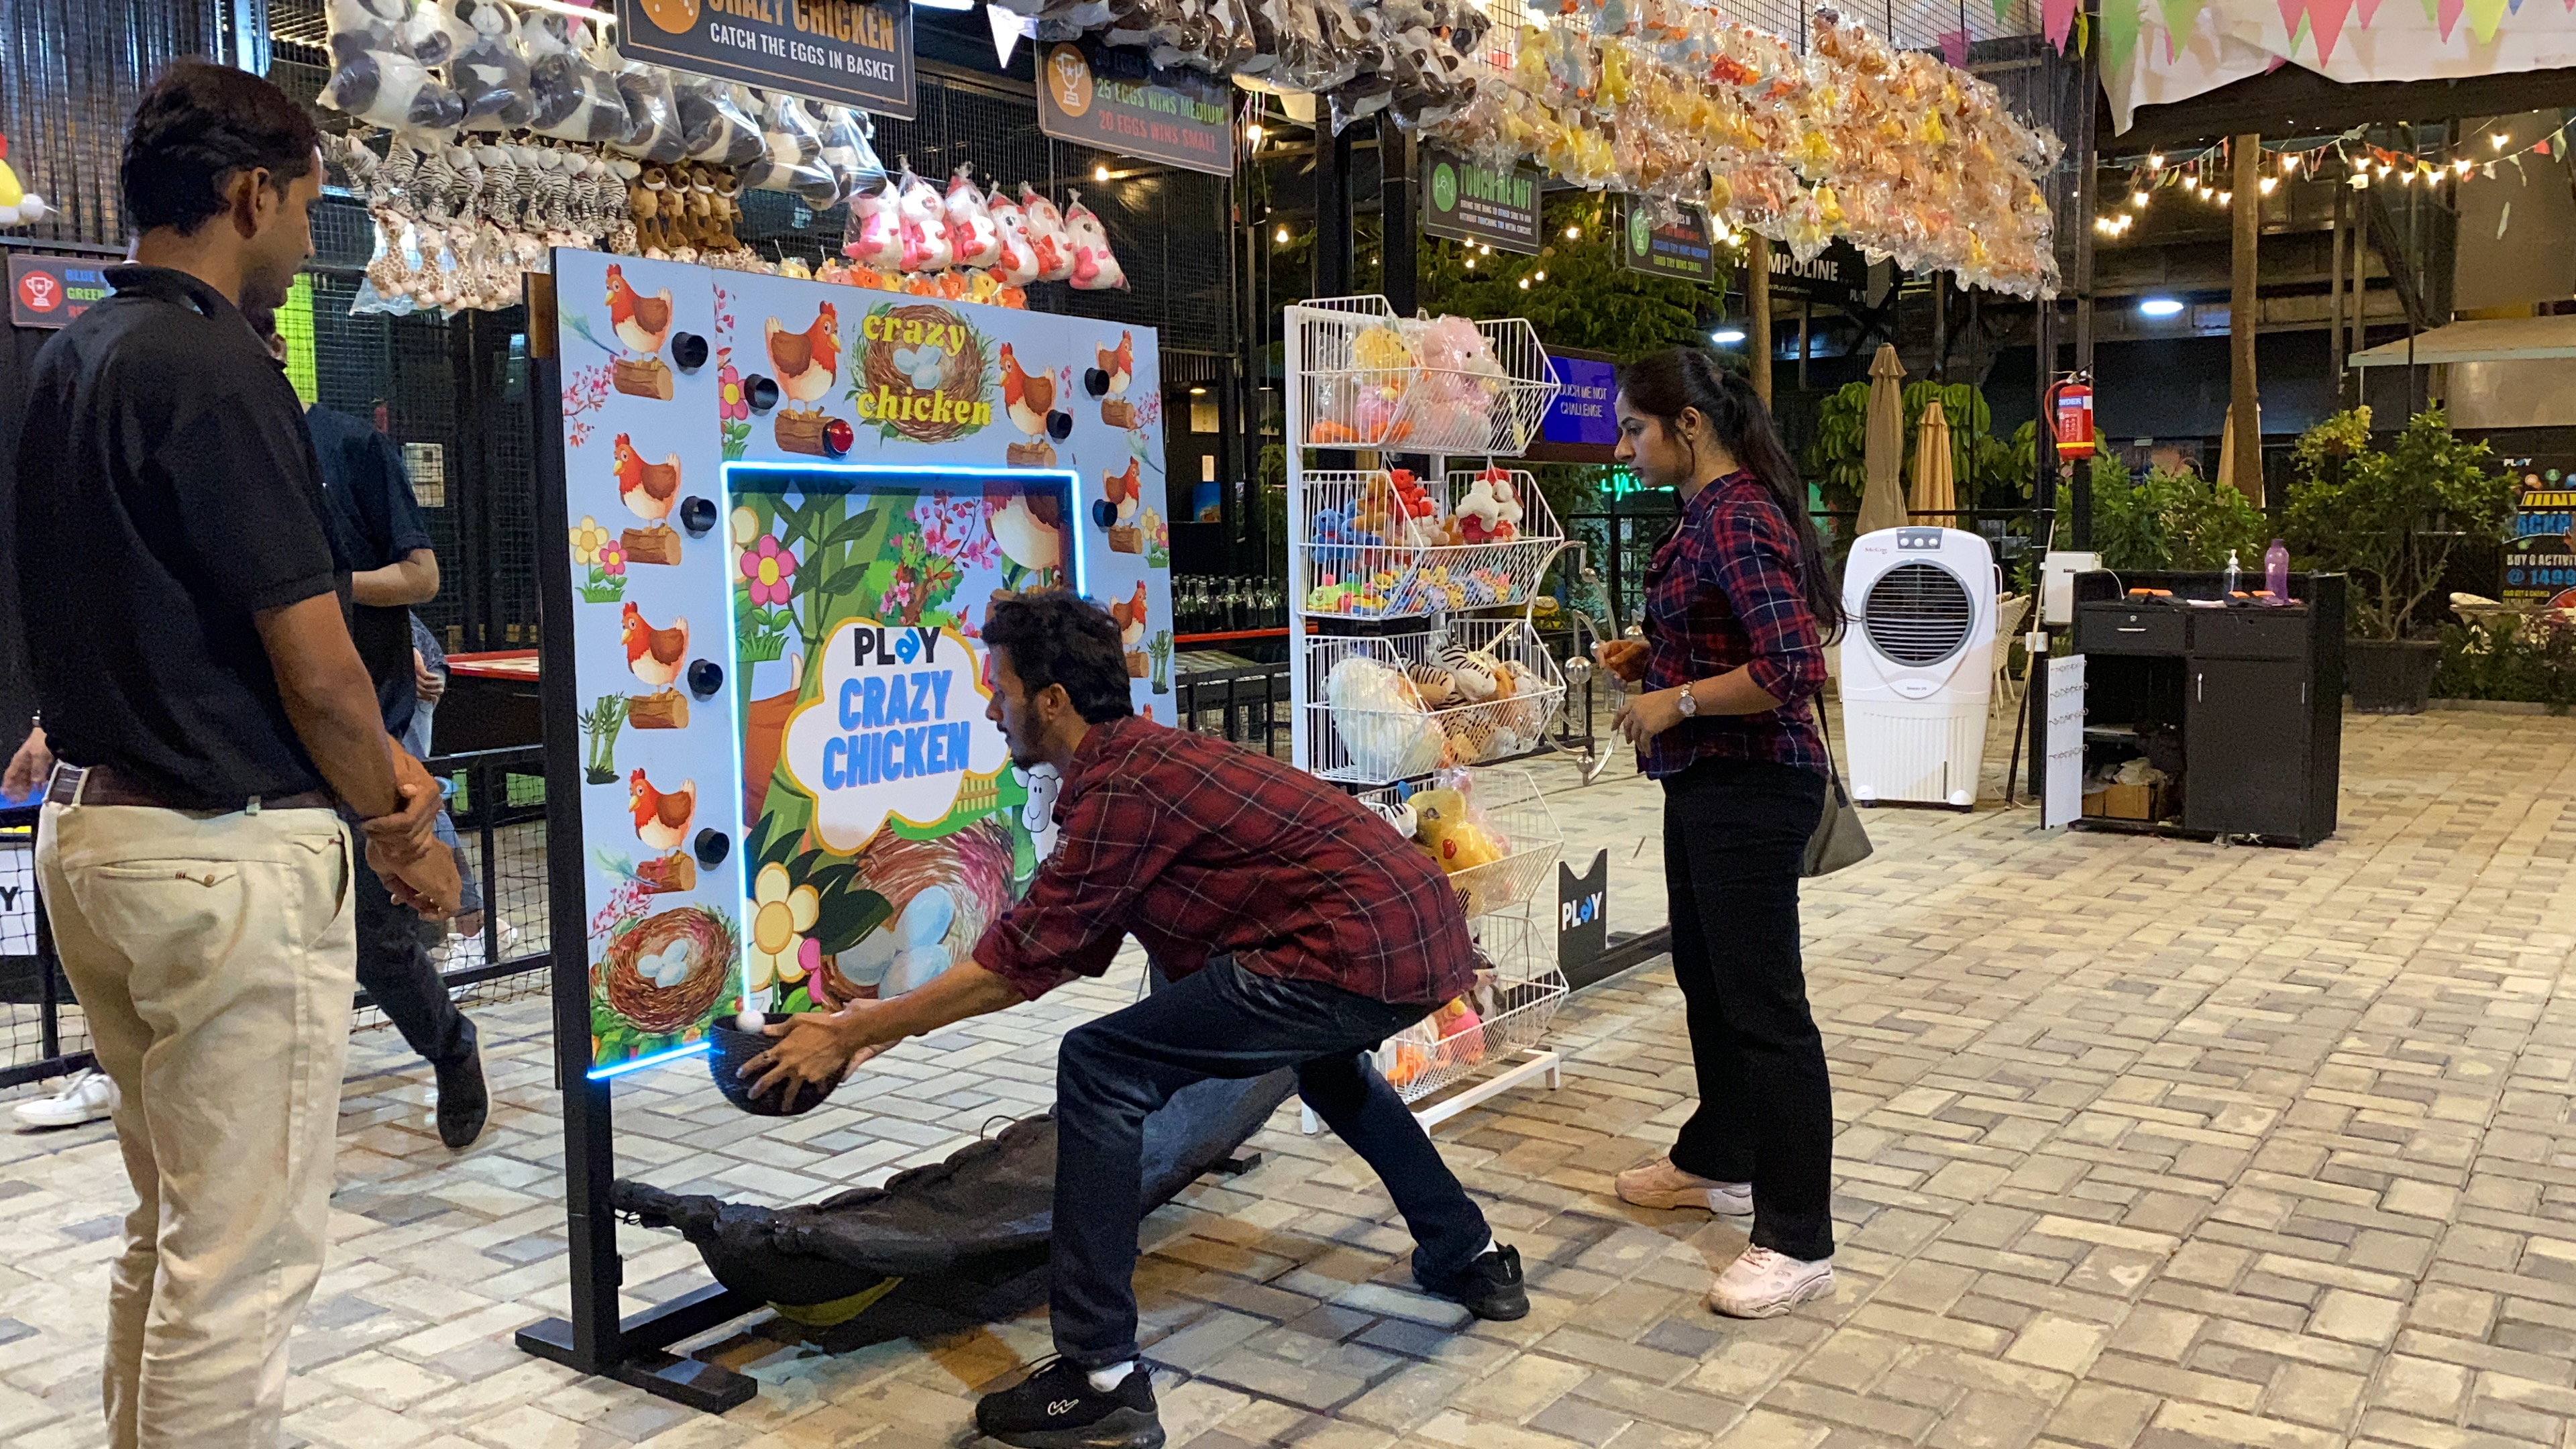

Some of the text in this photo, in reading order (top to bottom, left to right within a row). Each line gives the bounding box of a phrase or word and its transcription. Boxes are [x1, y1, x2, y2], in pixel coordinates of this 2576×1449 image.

[792, 0, 894, 52] CHICKEN
[710, 22, 894, 82] CATCH THE EGGS IN BASKET
[1097, 77, 1224, 125] 25 EGGS WINS MEDIUM
[1099, 109, 1218, 153] 20 EGGS WINS SMALL
[1459, 163, 1532, 211] TOUCH ME NOT
[65, 269, 95, 283] BLUE
[1768, 252, 1838, 282] MPOLINE
[68, 305, 89, 318] RE
[863, 314, 966, 357] crazy
[856, 384, 991, 426] chicken
[1559, 384, 1607, 400] OUCH ME NOT
[1560, 401, 1603, 417] CHALLENGE
[839, 670, 953, 731] CRAZY
[822, 720, 971, 790] CHICKEN
